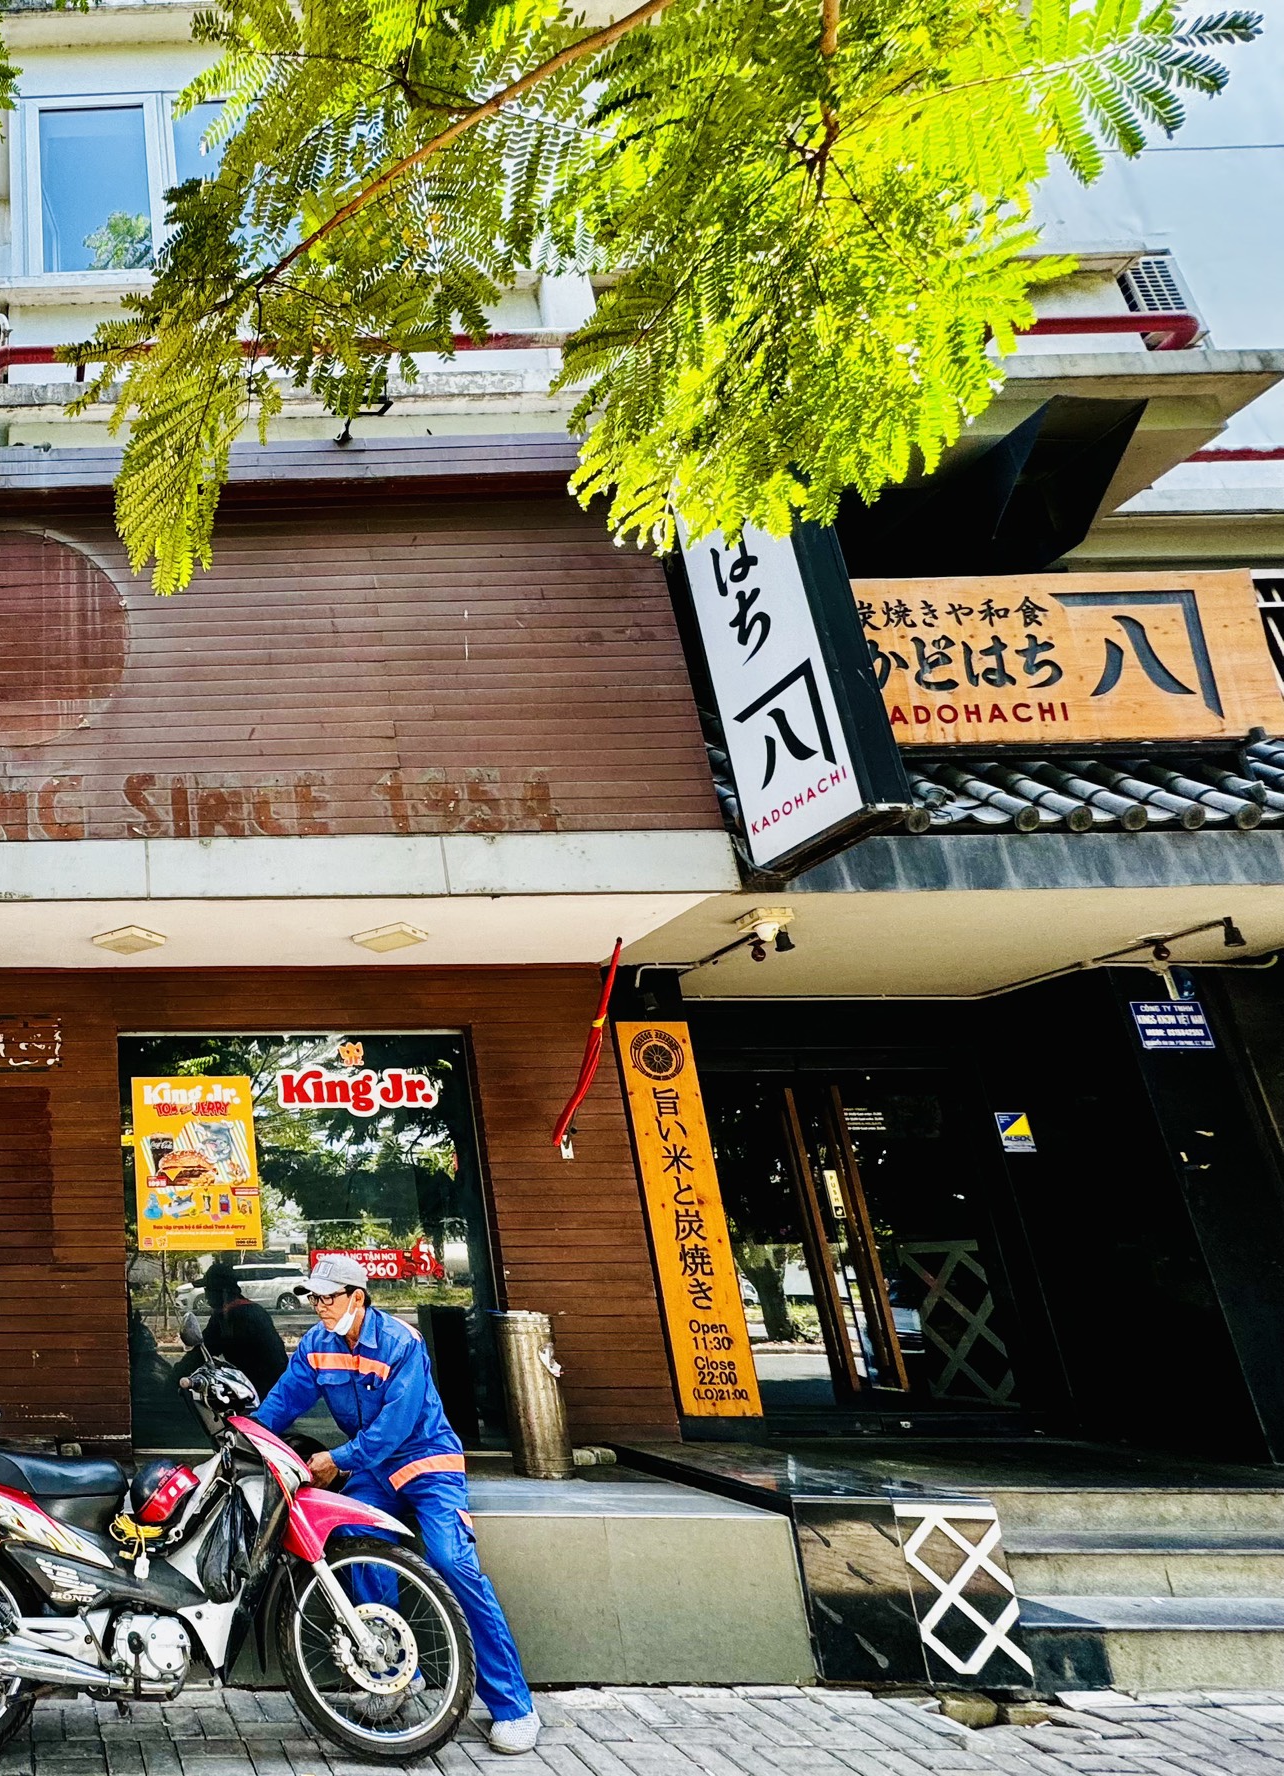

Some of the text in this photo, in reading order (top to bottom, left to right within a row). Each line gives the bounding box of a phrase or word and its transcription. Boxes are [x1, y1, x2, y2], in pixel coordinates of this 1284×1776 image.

[889, 701, 1070, 726] ADOHACHI
[750, 764, 848, 837] KADOHACHI
[143, 1082, 241, 1108] King Jr.
[281, 1070, 433, 1112] King Jr.
[154, 1102, 179, 1117] TOM
[192, 1101, 231, 1116] JERRY
[652, 1087, 715, 1311] 旨い米と炭焼き
[689, 1319, 728, 1335] Open
[692, 1336, 732, 1351] 11:30
[694, 1356, 736, 1371] Close
[698, 1371, 738, 1386] 22:00
[49, 1591, 94, 1603] HOND
